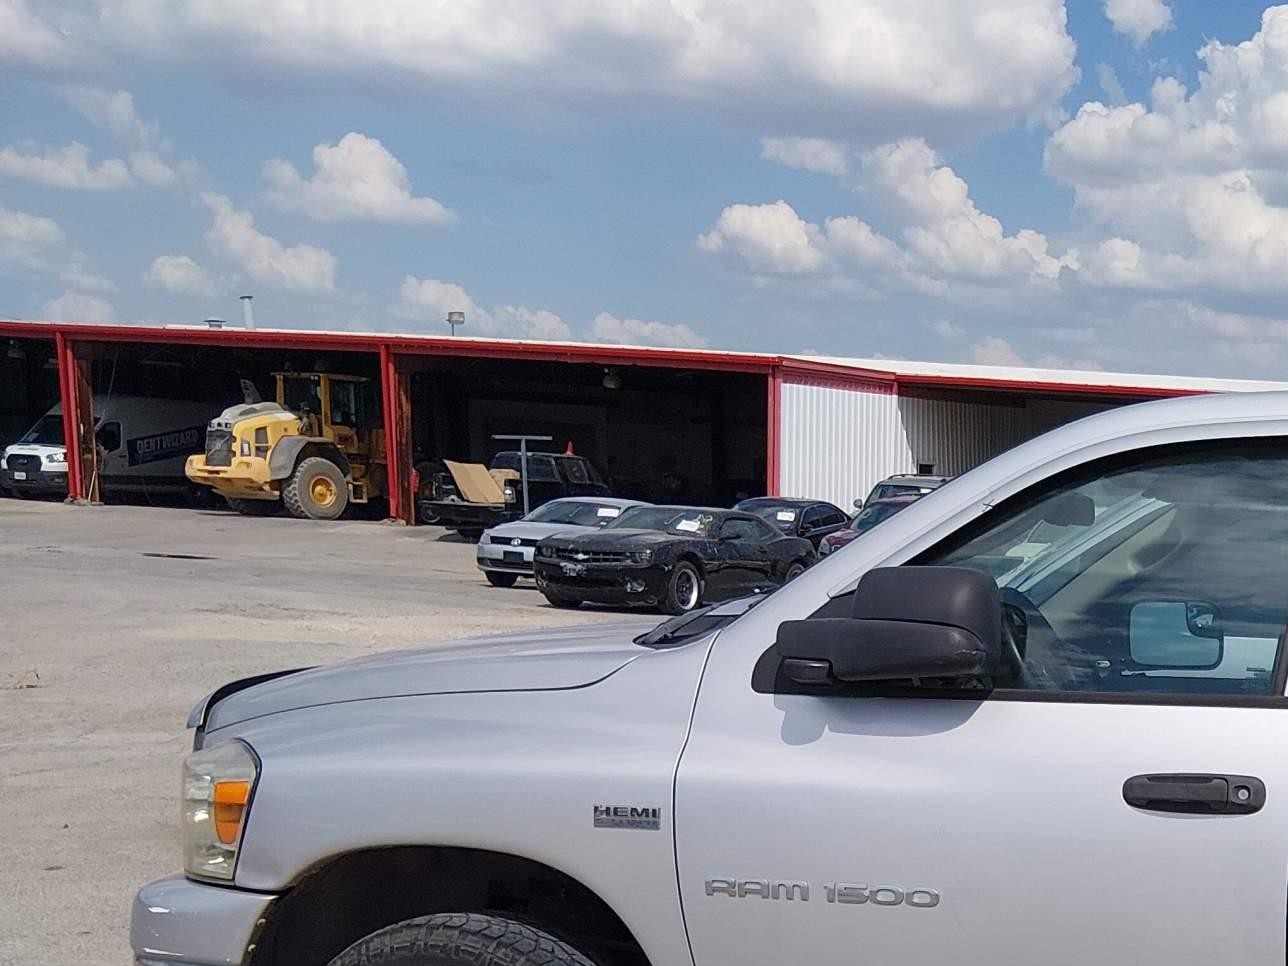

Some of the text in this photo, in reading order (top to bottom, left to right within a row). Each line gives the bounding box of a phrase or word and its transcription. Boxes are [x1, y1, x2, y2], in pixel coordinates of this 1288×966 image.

[594, 806, 658, 818] HEMI
[704, 876, 941, 908] RAM 1500
